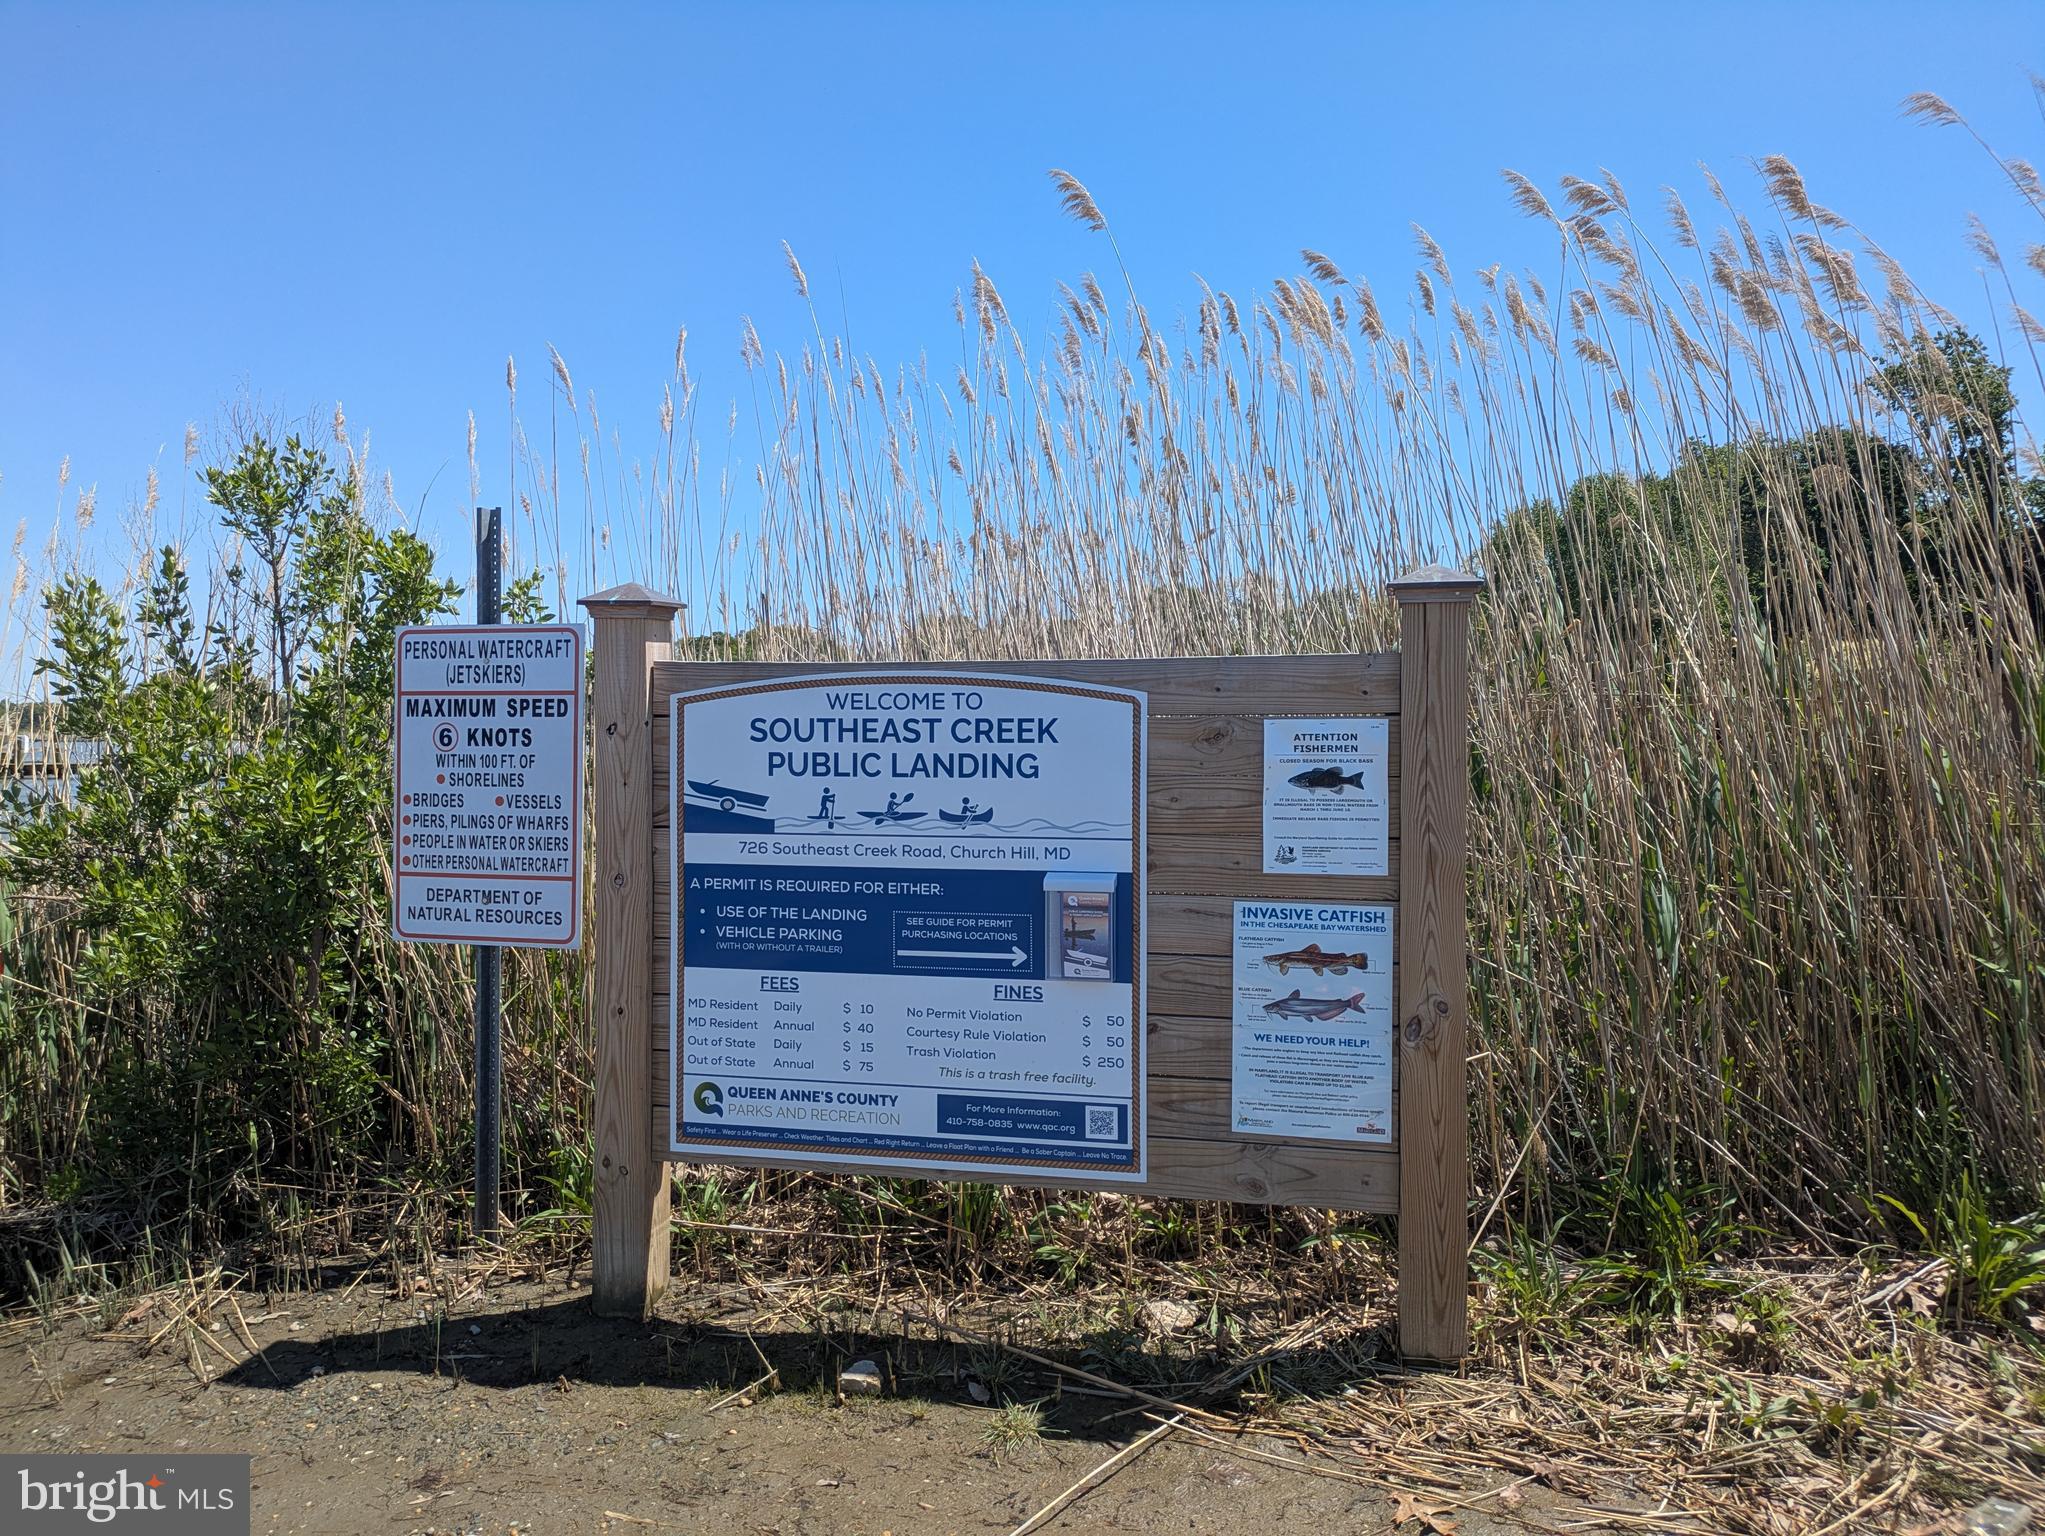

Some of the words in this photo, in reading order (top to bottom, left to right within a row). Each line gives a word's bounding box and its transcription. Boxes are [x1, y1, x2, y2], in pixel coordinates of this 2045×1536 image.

[405, 641, 474, 659] PERSONAL
[478, 639, 571, 659] WATERCRAFT
[447, 664, 525, 687] (JETSKIERS)
[407, 699, 495, 717] MAXIMUM
[507, 698, 568, 717] SPEED
[826, 693, 947, 710] WELCOME
[952, 692, 982, 710] TO
[439, 728, 453, 746] 6
[468, 728, 532, 747] KNOTS
[750, 718, 944, 743] SOUTHEAST
[951, 718, 1058, 743] CREEK
[1294, 733, 1357, 741] ATTENTION
[436, 754, 476, 768] WITHIN
[480, 754, 497, 768] 100
[501, 754, 516, 768] FT.
[520, 754, 535, 768] OF
[769, 752, 881, 777] PUBLIC
[890, 753, 1040, 778] LANDING
[449, 772, 524, 787] SHORELINES
[413, 793, 464, 808] BRIDGES
[506, 794, 561, 809] VESSELS
[413, 814, 447, 830] PIERS,
[451, 815, 494, 829] PILINGS
[498, 815, 513, 829] OF
[516, 816, 568, 830] WHARFS
[413, 834, 453, 848] PEOPLE
[457, 835, 466, 849] IN
[469, 835, 506, 850] WATER
[510, 836, 525, 850] OR
[528, 837, 568, 851] SKIERS
[739, 841, 768, 854] 726
[773, 842, 849, 856] Southeast
[854, 844, 897, 856] Creek
[903, 845, 945, 858] Road,
[951, 846, 1005, 858] Church
[1012, 847, 1038, 860] Hill,
[1045, 847, 1070, 860] MD
[413, 854, 443, 869] OTHER
[446, 855, 498, 870] PERSONAL
[501, 857, 568, 872] WATERCRAFT
[690, 878, 700, 888] A
[705, 878, 756, 890] PERMIT
[760, 880, 774, 890] IS
[777, 880, 850, 892] REQUIRED
[855, 882, 885, 893] FOR
[889, 881, 943, 895] EITHER:
[427, 888, 519, 905] DEPARTMENT
[524, 891, 542, 905] OF
[408, 906, 471, 922] NATURAL
[476, 909, 562, 925] RESOURCES
[717, 906, 744, 917] USE
[748, 907, 767, 918] OF
[770, 907, 798, 919] THE
[803, 908, 866, 921] LANDING
[1241, 907, 1313, 920] INVASIVE
[1318, 910, 1385, 923] CATFISH
[926, 918, 954, 926] GUIDE
[978, 919, 1012, 927] PERMIT
[1268, 922, 1319, 930] CHESAPEAKE
[1337, 924, 1387, 933] WATERSHED
[716, 926, 775, 940] VEHICLE
[780, 928, 842, 942] PARKING
[902, 930, 962, 939] PURCHASING
[964, 932, 1017, 940] LOCATIONS
[755, 943, 795, 951] WITHOUT
[805, 945, 842, 954] TRAILER)
[760, 976, 799, 990] FEES
[993, 985, 1043, 1000] FINES
[689, 999, 706, 1008] MD
[710, 999, 758, 1010] Resident
[774, 1001, 802, 1014] Daily
[861, 1004, 873, 1014] 10
[907, 1006, 923, 1017] No
[927, 1006, 966, 1019] Permit
[969, 1008, 1022, 1021] Violation
[1107, 1016, 1124, 1026] 50
[688, 1017, 706, 1027] MD
[710, 1019, 758, 1029] Resident
[774, 1020, 814, 1031] Annual
[858, 1024, 873, 1033] 40
[688, 1036, 708, 1045] Out
[711, 1037, 723, 1046] of
[725, 1038, 755, 1048] State
[774, 1039, 802, 1052] Daily
[861, 1043, 873, 1052] 15
[907, 1027, 960, 1041] Courtesy
[964, 1029, 989, 1040] Rule
[993, 1031, 1046, 1042] Violation
[1107, 1037, 1124, 1047] 50
[1254, 1033, 1272, 1042] WE
[1275, 1035, 1304, 1044] NEED
[1305, 1037, 1335, 1046] YOUR
[1339, 1039, 1369, 1048] HELP!
[688, 1056, 708, 1064] Out
[711, 1056, 722, 1065] of
[725, 1056, 755, 1067] State
[774, 1058, 815, 1069] Annual
[859, 1062, 873, 1071] 75
[906, 1046, 940, 1056] Trash
[943, 1048, 995, 1059] Violation
[1098, 1057, 1124, 1068] 250
[939, 1067, 962, 1077] This
[966, 1068, 974, 1078] is
[978, 1072, 985, 1080] a
[989, 1069, 1020, 1080] trash
[1024, 1071, 1048, 1082] free
[1051, 1073, 1096, 1087] facility.
[728, 1086, 776, 1102] QUEEN
[780, 1089, 833, 1103] ANNE'S
[837, 1093, 898, 1107] COUNTY
[729, 1104, 770, 1117] PARKS
[775, 1106, 806, 1119] AND
[811, 1109, 901, 1125] RECREATION
[967, 1104, 981, 1112] For
[983, 1105, 1006, 1113] More
[1008, 1107, 1061, 1116] Information:
[687, 1126, 703, 1134] Safety
[753, 1130, 778, 1138] Preserver
[947, 1117, 1012, 1128] 410-758-0835
[1017, 1123, 1075, 1134] www.qac.org
